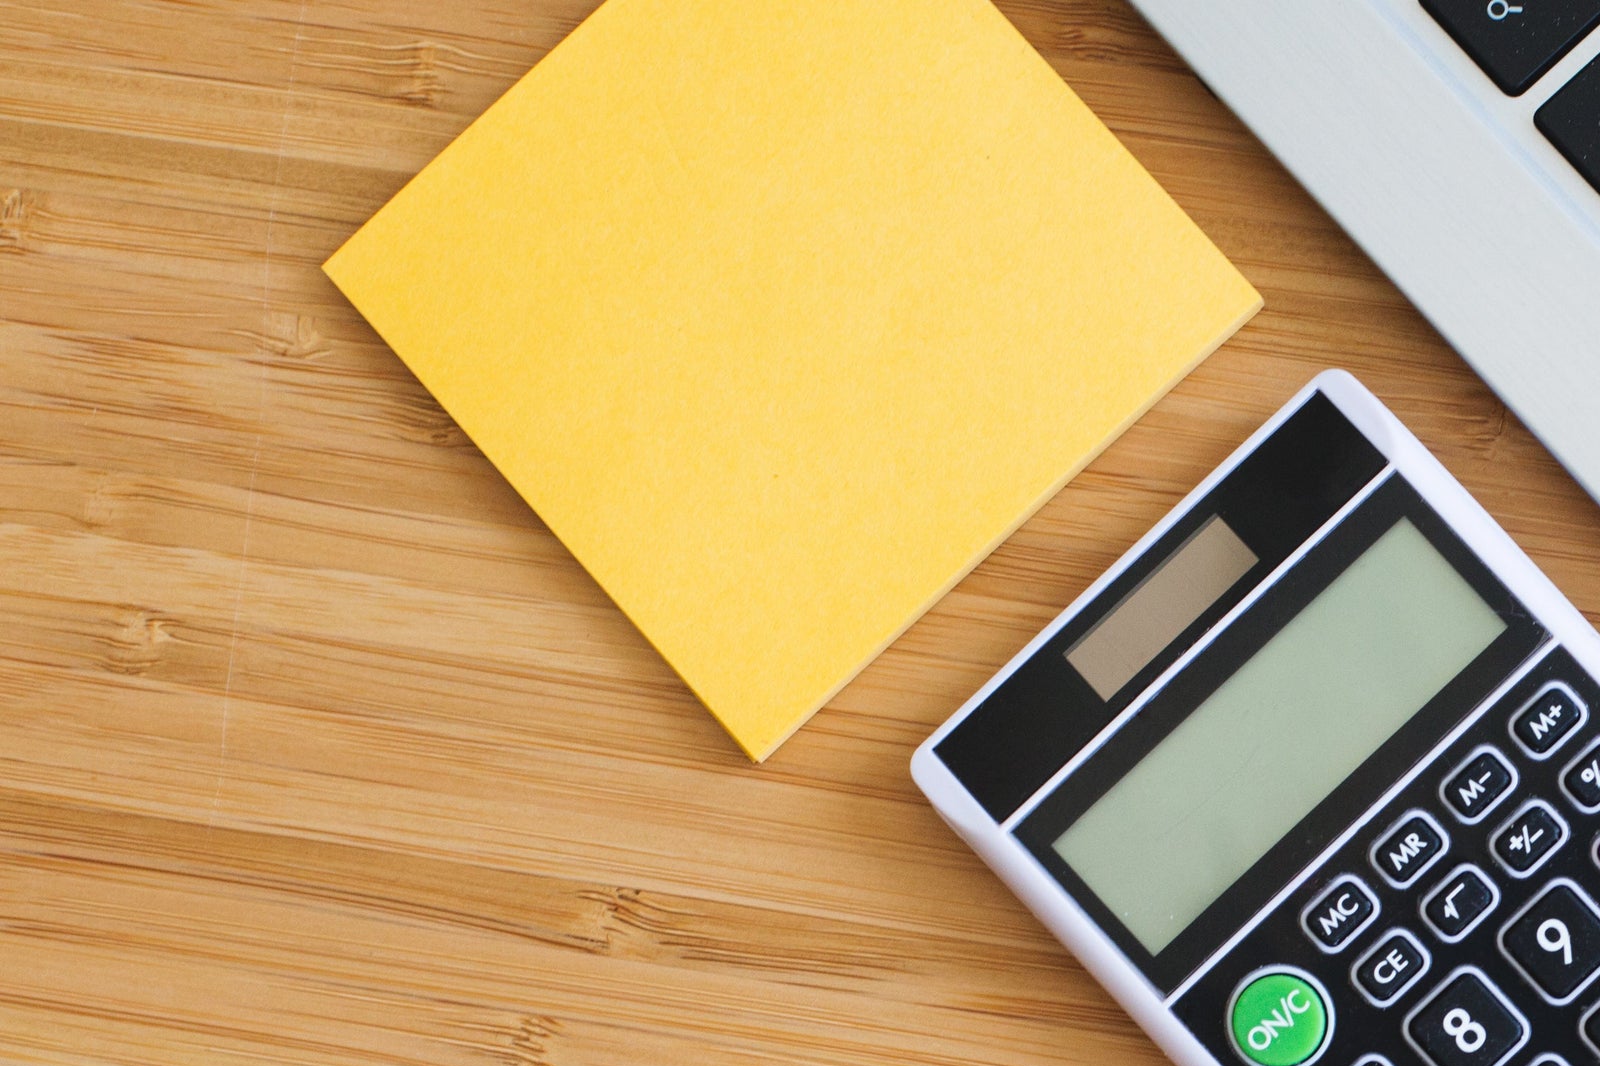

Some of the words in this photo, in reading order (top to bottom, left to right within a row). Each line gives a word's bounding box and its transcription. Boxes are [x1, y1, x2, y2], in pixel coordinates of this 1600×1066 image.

[1529, 704, 1562, 740] M+
[1458, 771, 1492, 807] M-
[1389, 832, 1428, 871] MR
[1509, 824, 1544, 854] +/-
[1319, 893, 1359, 936] MC
[1536, 918, 1573, 965] 9
[1373, 948, 1409, 985] CE
[1247, 988, 1311, 1051] ON/C
[1442, 1007, 1487, 1053] 8
